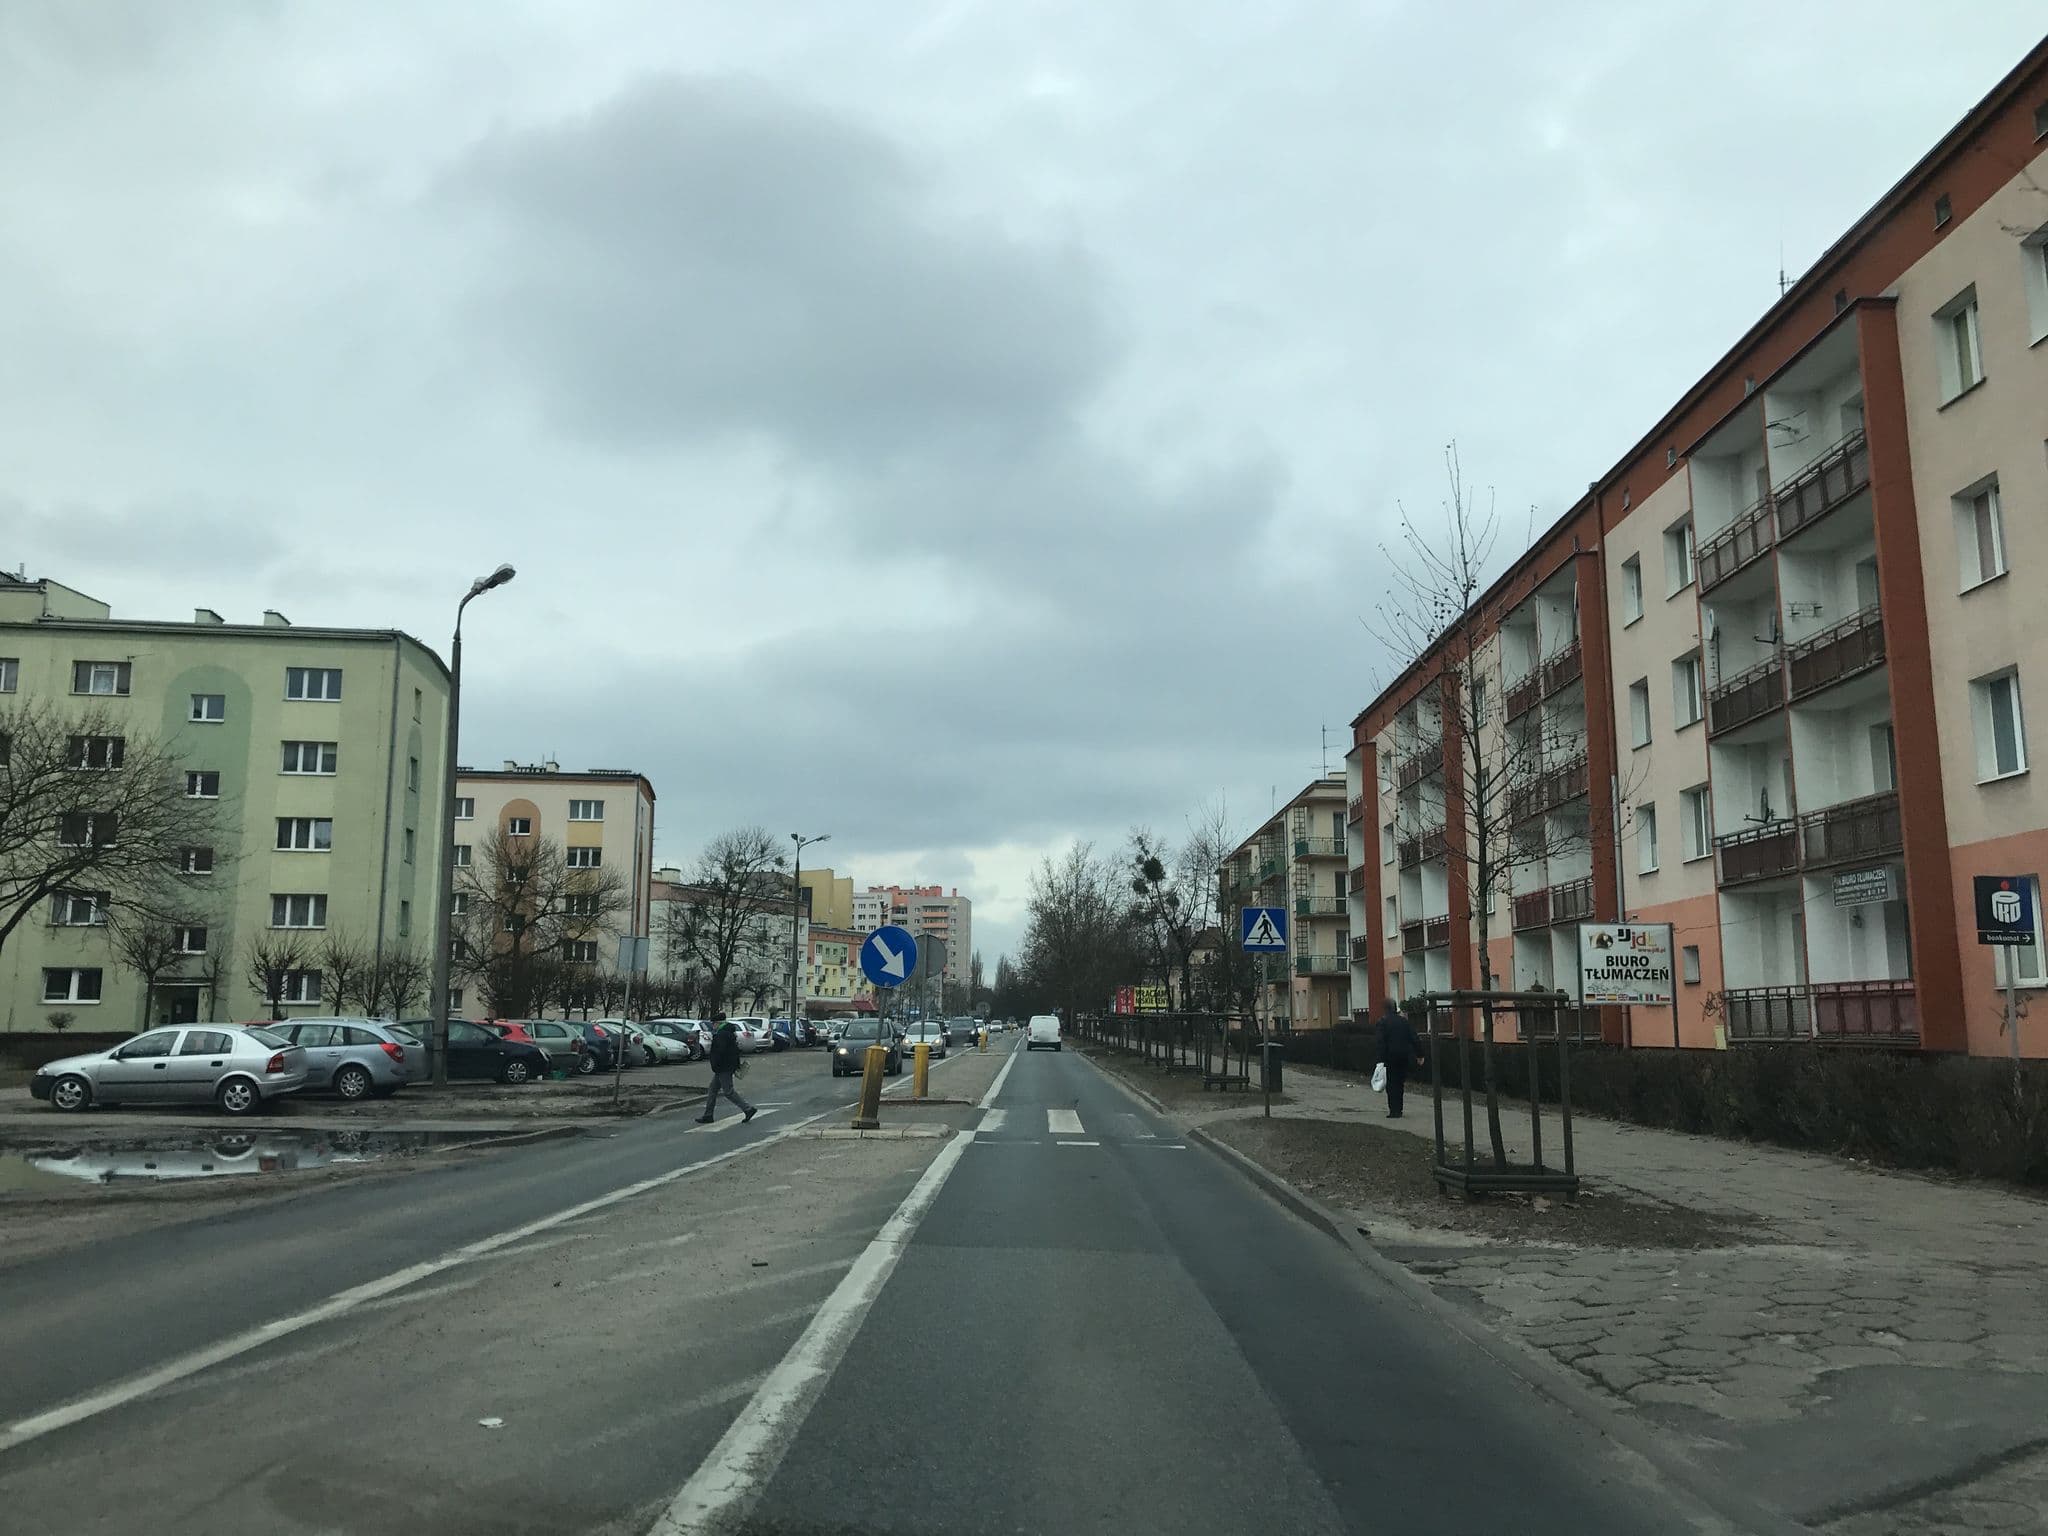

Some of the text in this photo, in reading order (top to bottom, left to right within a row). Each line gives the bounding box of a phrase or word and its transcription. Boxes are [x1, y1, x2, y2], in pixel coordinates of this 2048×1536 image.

[1992, 891, 2021, 923] PKO
[1986, 934, 2020, 942] bankomat
[1606, 955, 1650, 967] BIURO
[1584, 966, 1669, 980] TŁUMACZEŃ
